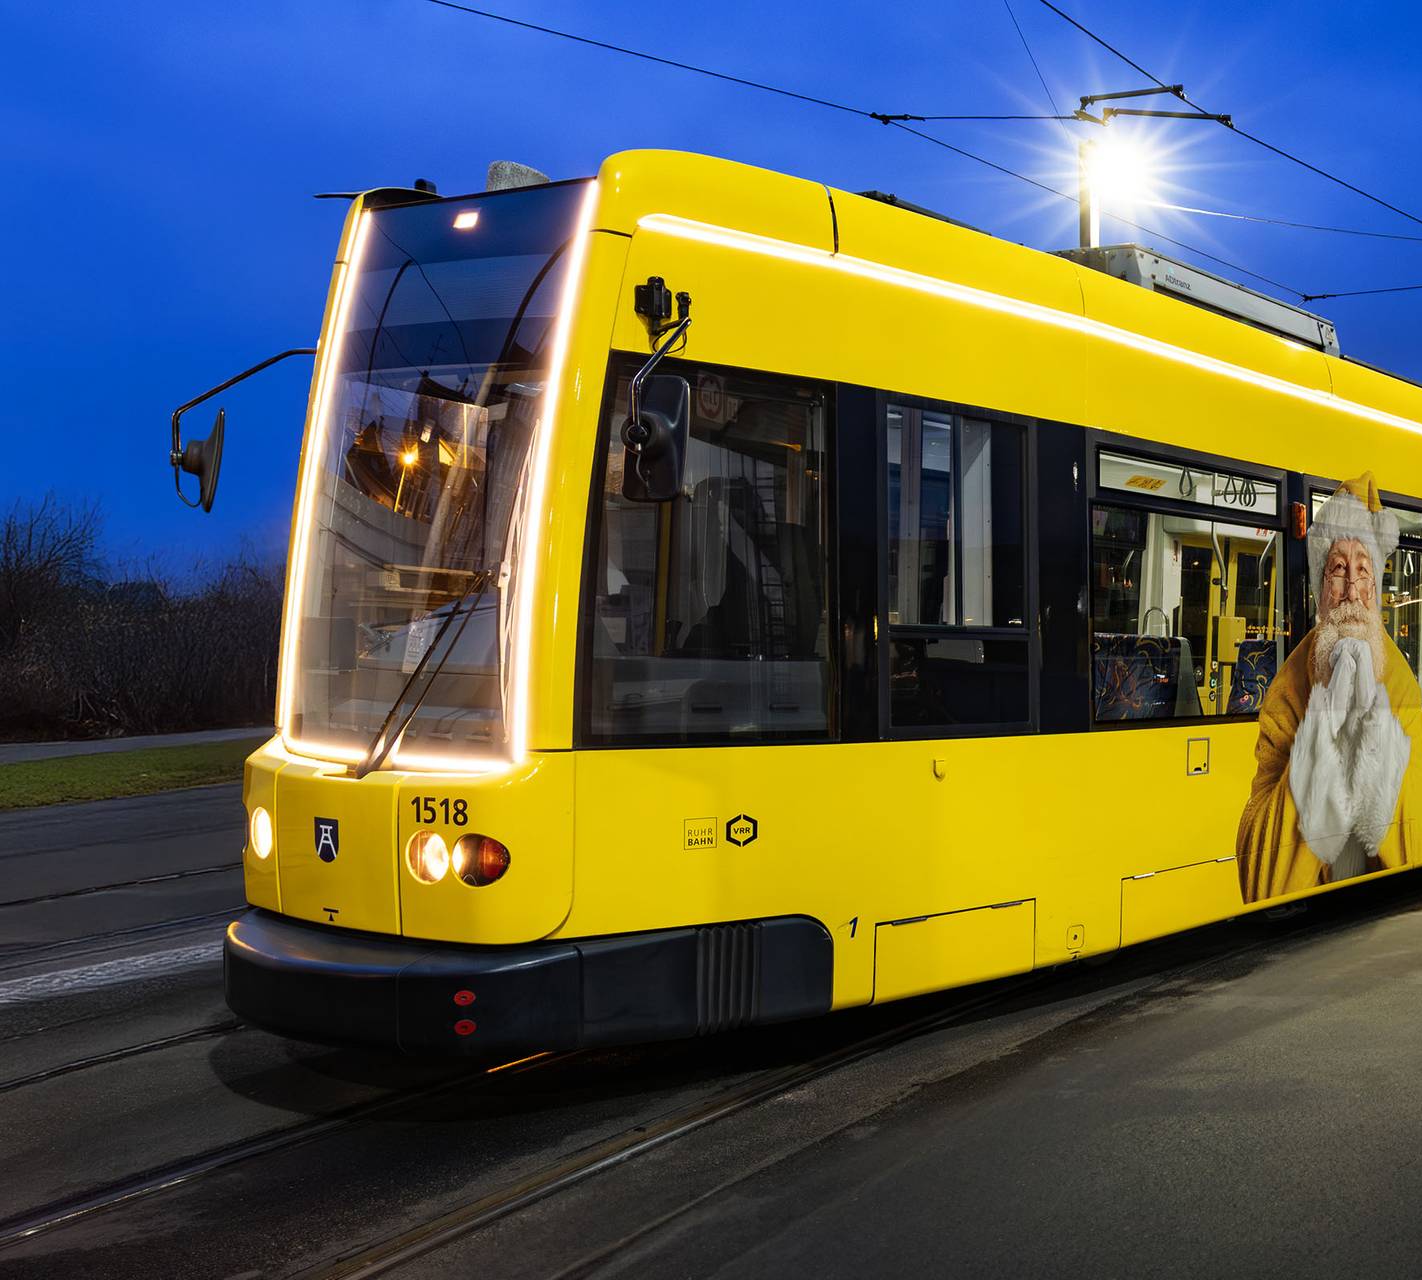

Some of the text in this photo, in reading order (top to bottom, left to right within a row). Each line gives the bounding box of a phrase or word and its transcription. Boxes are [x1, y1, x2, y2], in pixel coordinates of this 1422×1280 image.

[411, 796, 469, 827] 1518
[687, 827, 713, 837] RUHR
[733, 827, 751, 835] VRR
[687, 836, 714, 847] BAHN
[849, 916, 859, 938] 1
